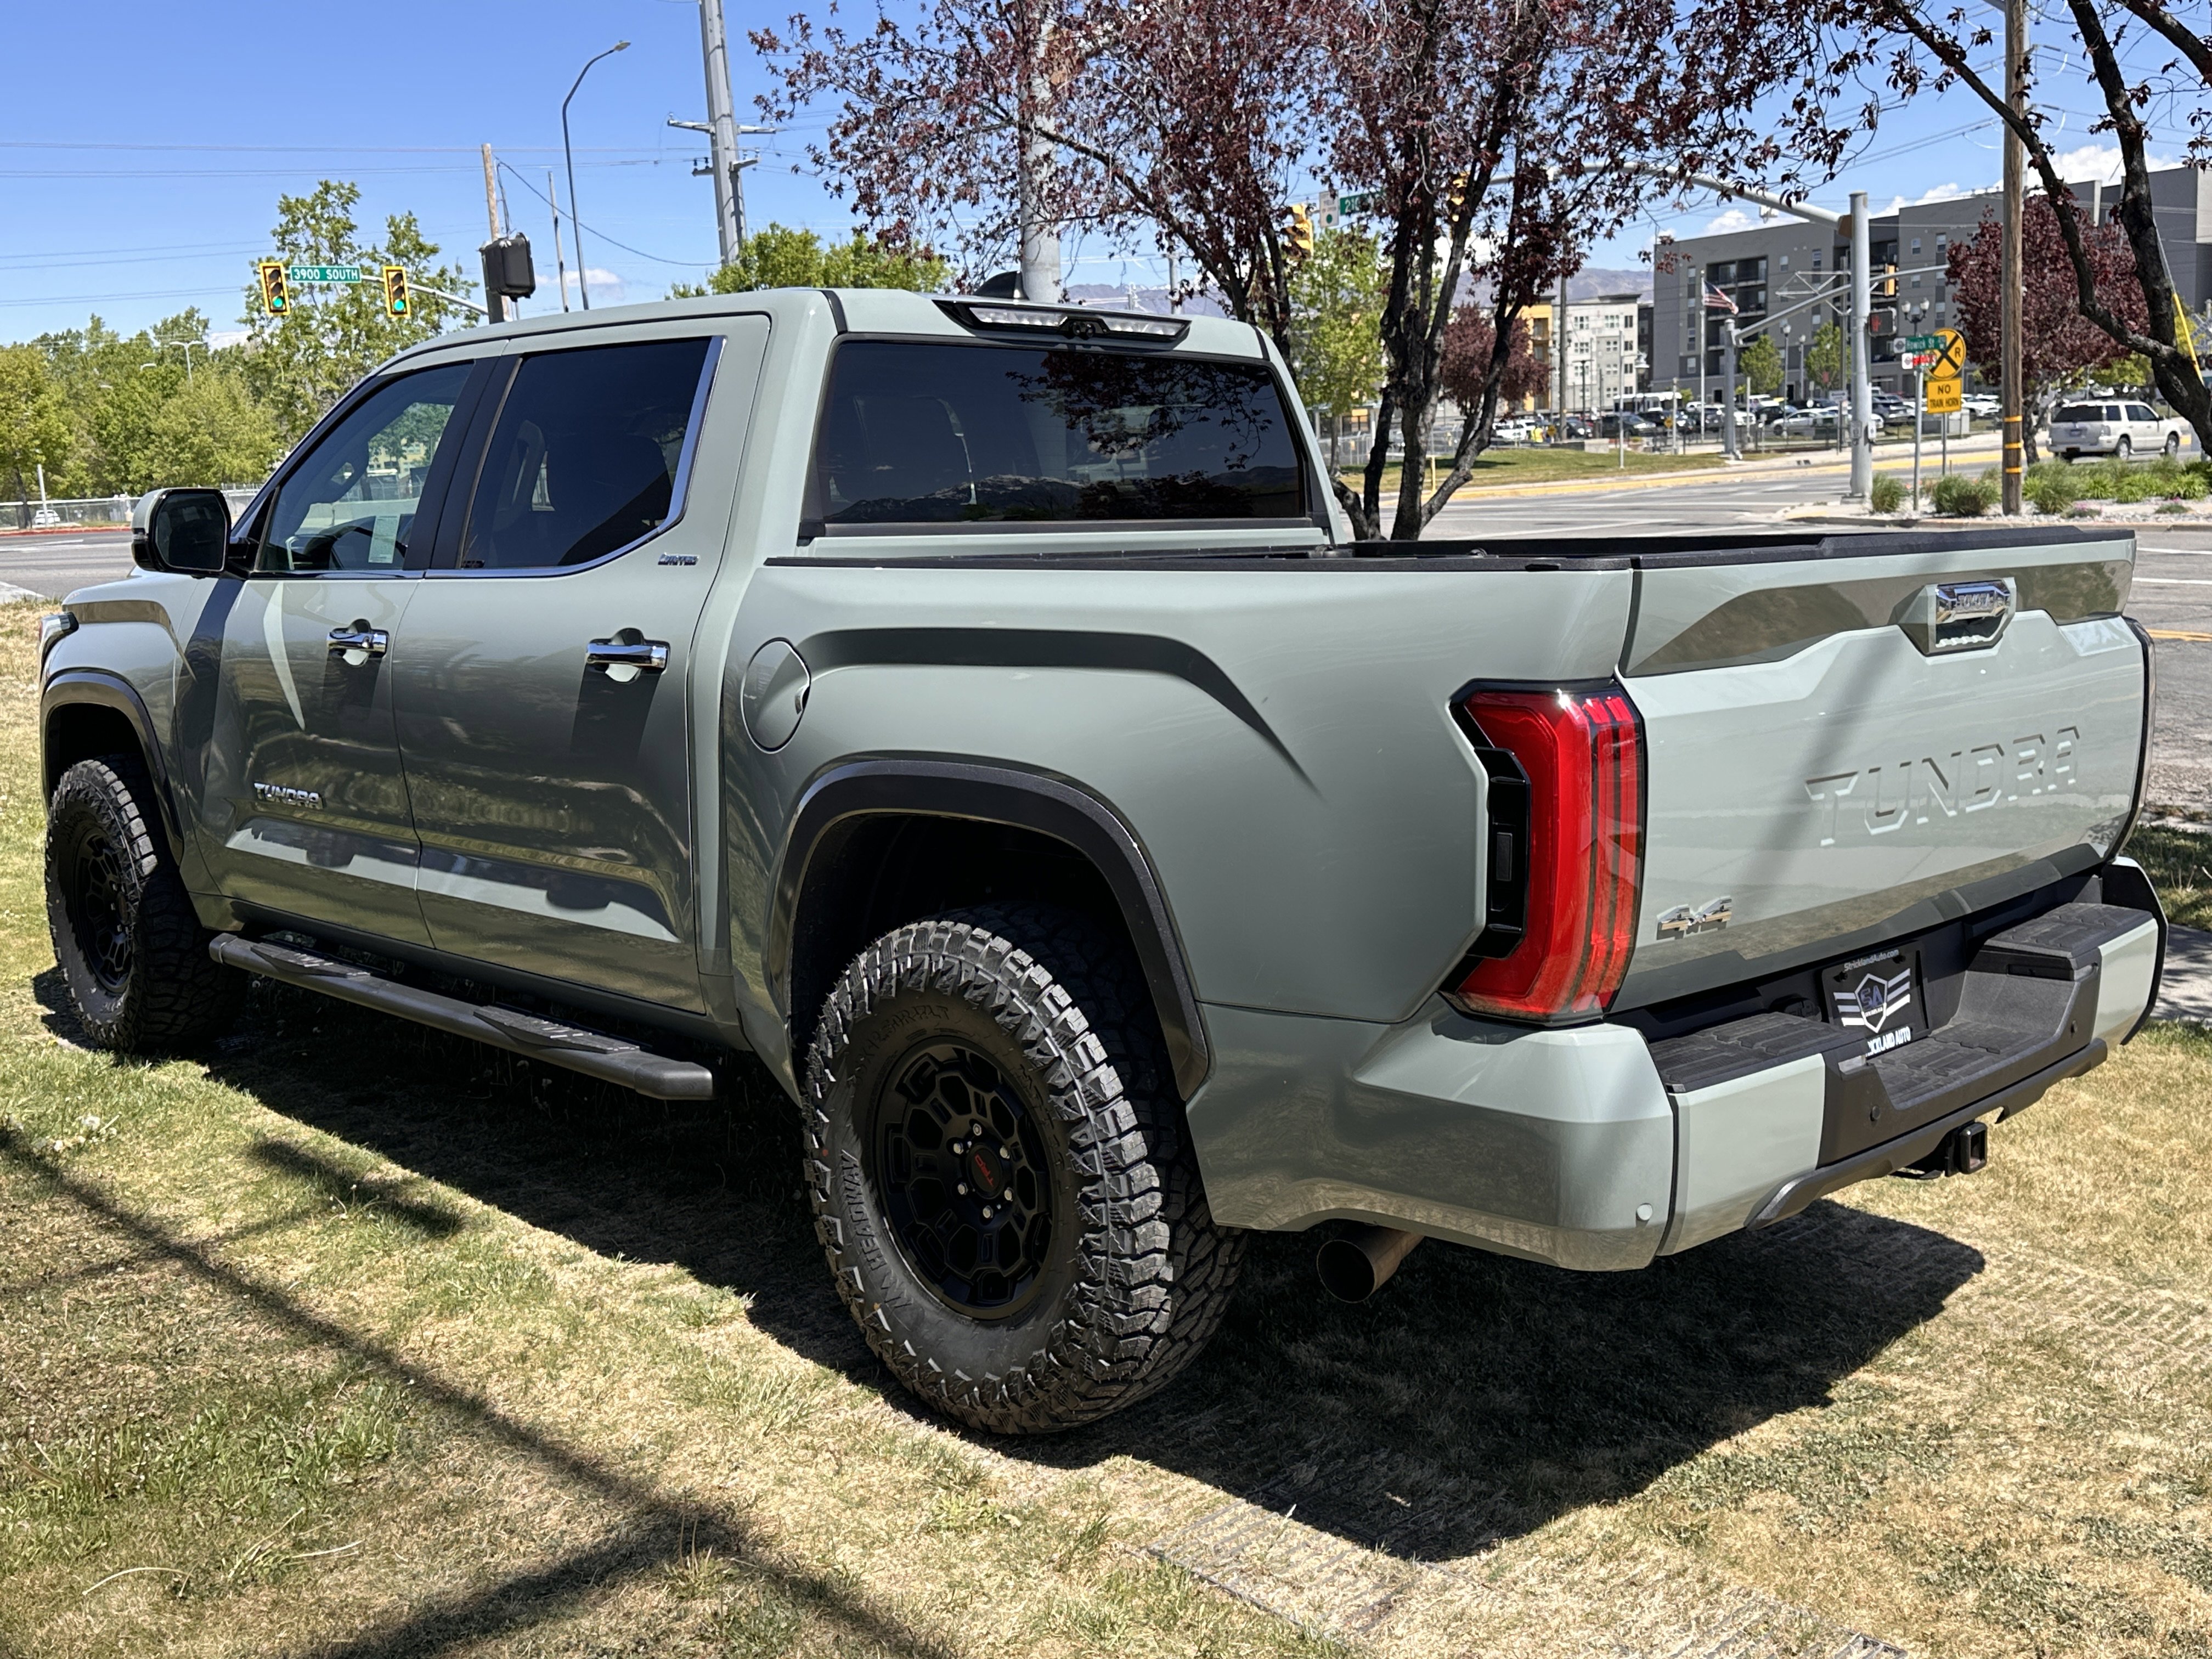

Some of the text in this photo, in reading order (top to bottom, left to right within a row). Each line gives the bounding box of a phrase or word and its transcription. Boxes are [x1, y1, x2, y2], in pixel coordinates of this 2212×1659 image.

[294, 268, 358, 280] 3900 SOUTH
[1954, 347, 1961, 358] R
[1937, 385, 1951, 395] NO
[1929, 397, 1959, 409] TRAIN HORN
[1957, 592, 1992, 610] TOYOTA
[1805, 725, 2080, 847] TUNDRA
[254, 782, 324, 810] TUNDRA
[1843, 949, 1899, 972] StricklandAuto.com
[1895, 1026, 1911, 1046] AUTO
[841, 1149, 888, 1272] HEADWAY
